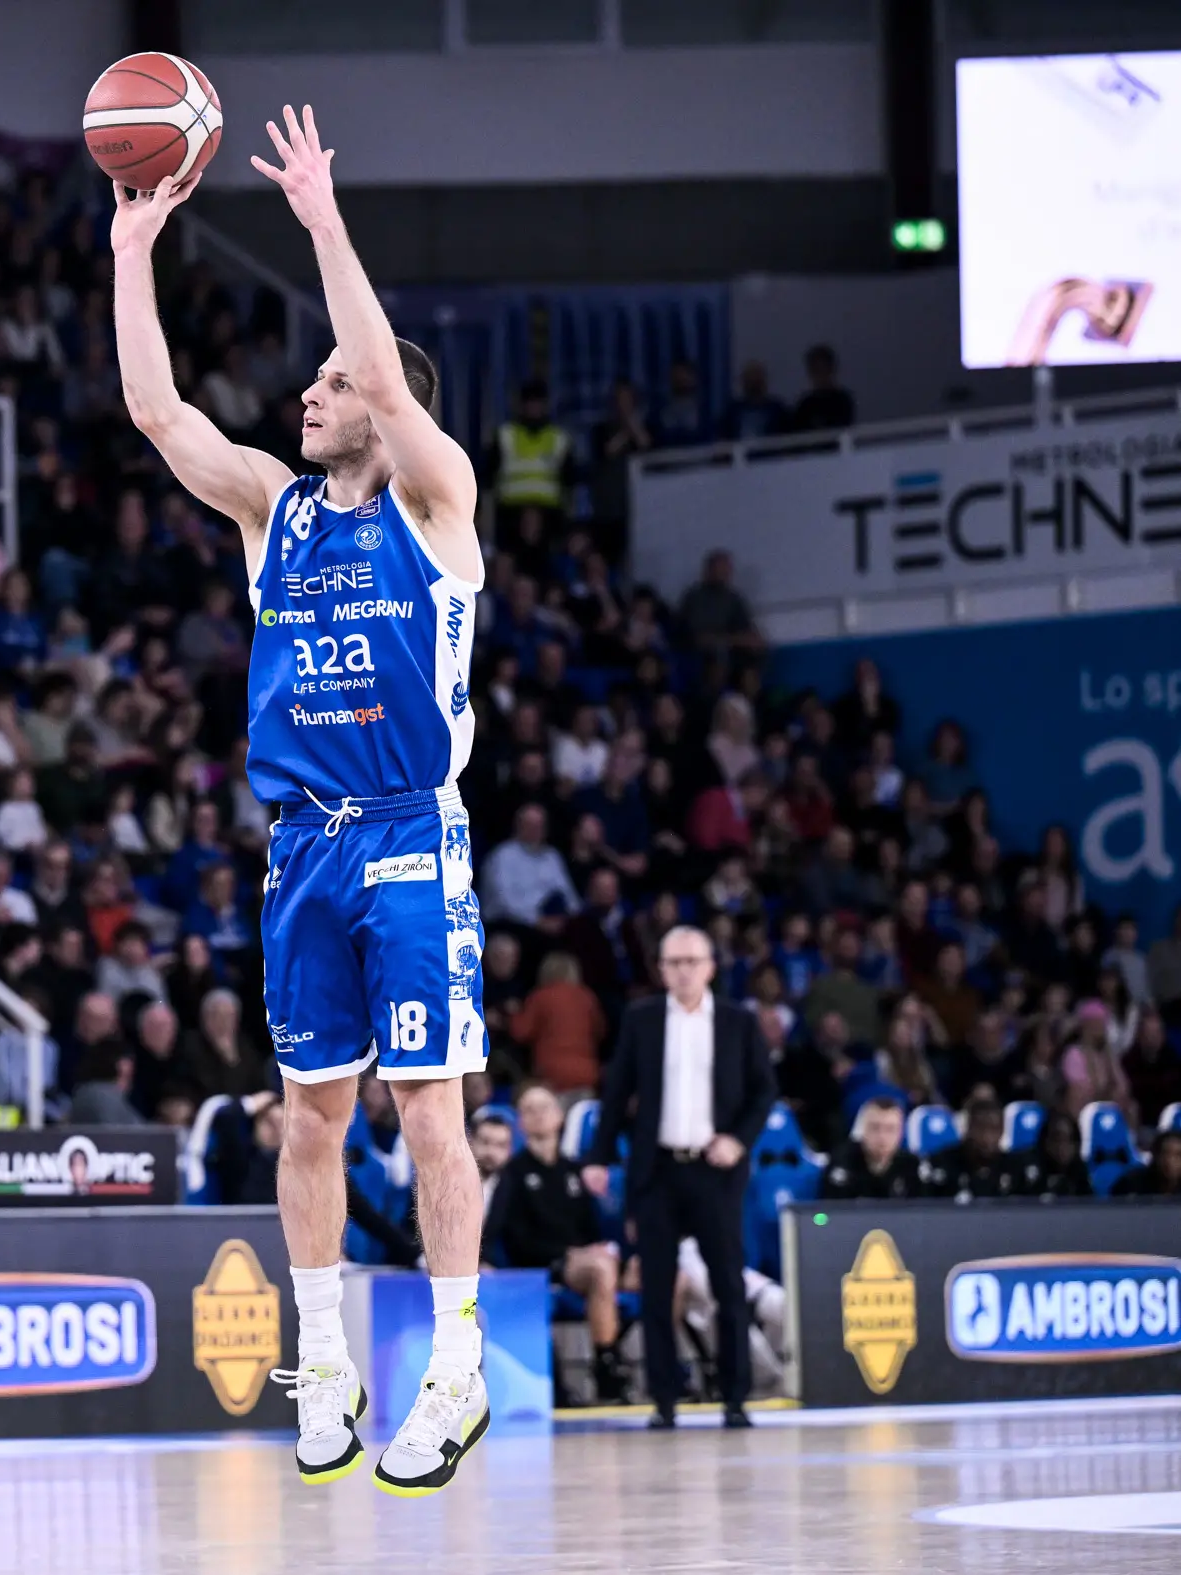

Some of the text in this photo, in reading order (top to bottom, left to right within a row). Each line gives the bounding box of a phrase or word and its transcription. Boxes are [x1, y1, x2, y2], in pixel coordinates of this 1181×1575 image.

[833, 467, 1181, 573] TECHNE
[281, 567, 374, 597] ECHNE
[320, 561, 372, 575] METROLOGIA
[293, 633, 375, 678] a2a
[320, 677, 376, 692] COMPANY
[1081, 737, 1181, 873] a
[401, 862, 432, 872] ZIRONI
[390, 1001, 427, 1051] 18
[1006, 1277, 1179, 1341] AMBROSI
